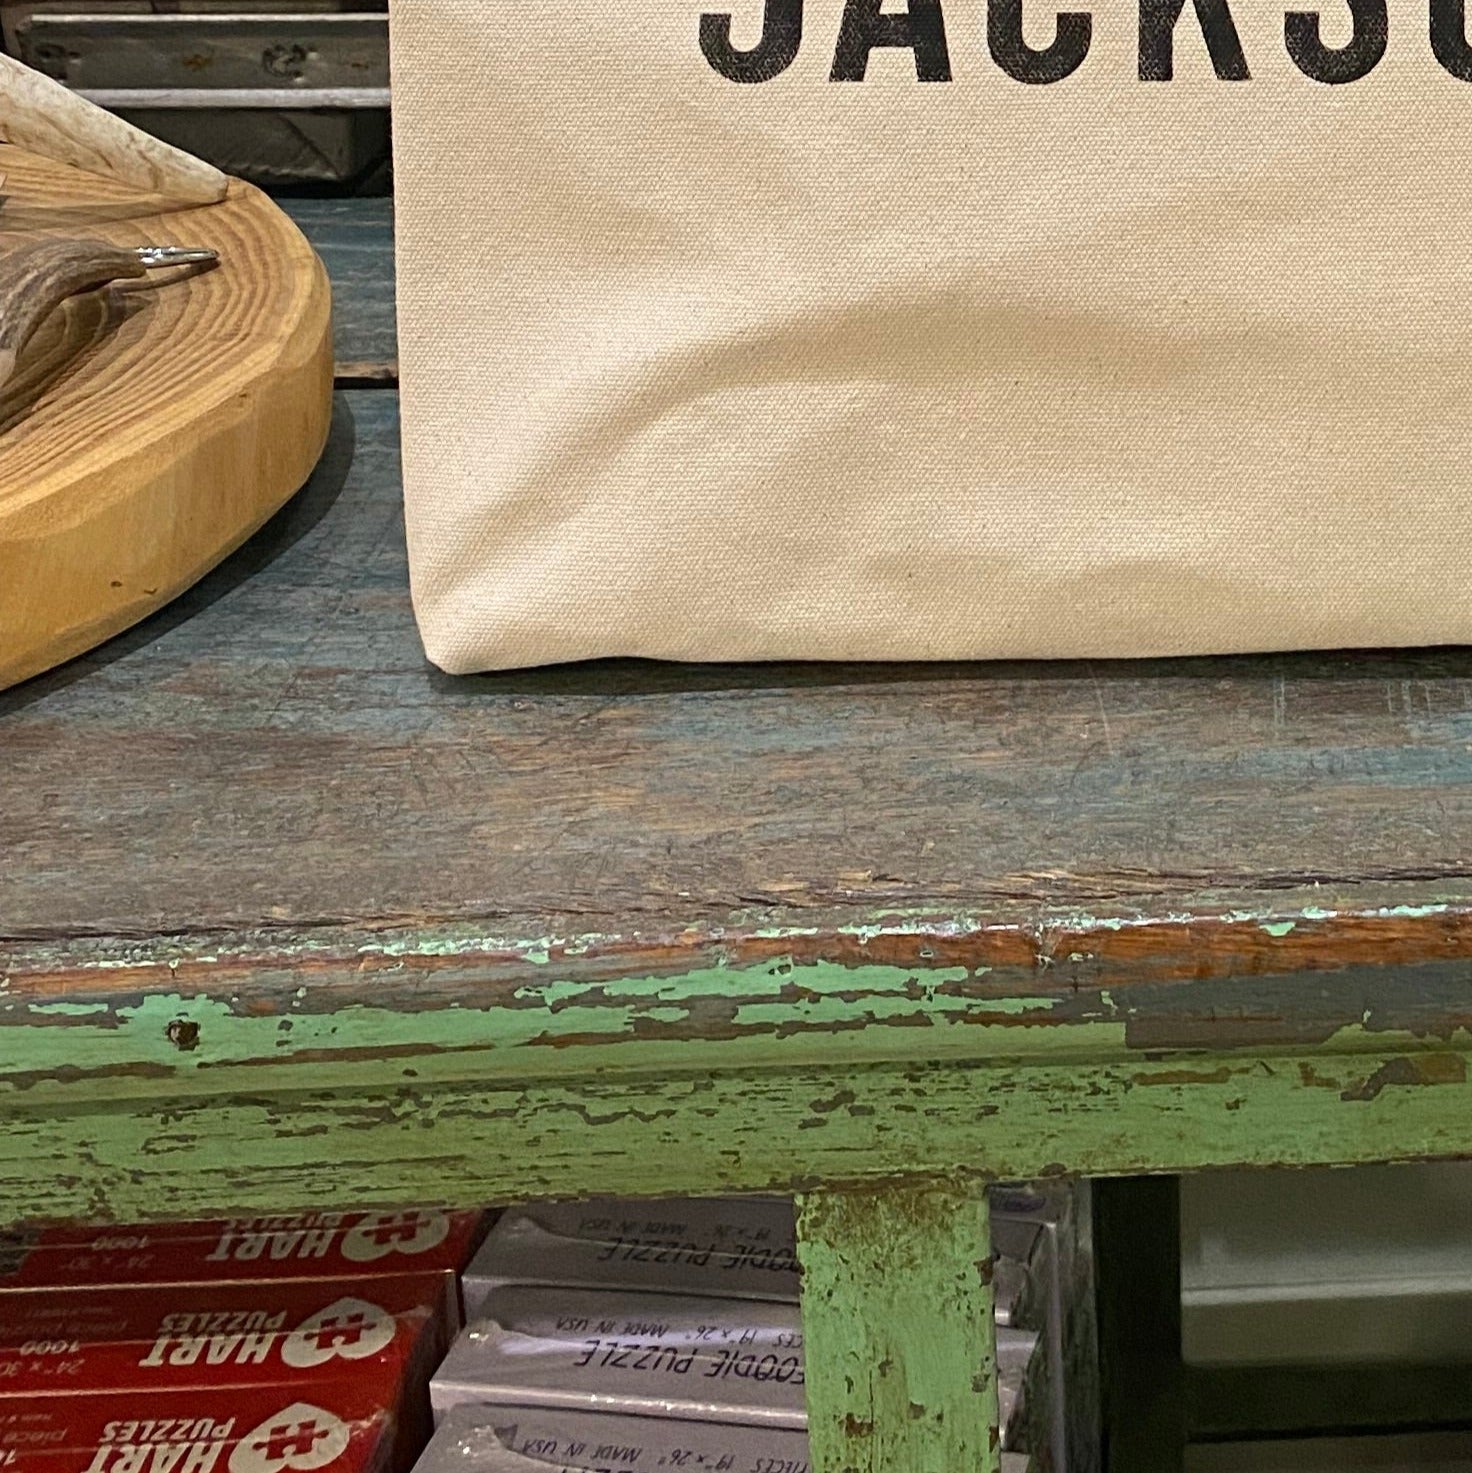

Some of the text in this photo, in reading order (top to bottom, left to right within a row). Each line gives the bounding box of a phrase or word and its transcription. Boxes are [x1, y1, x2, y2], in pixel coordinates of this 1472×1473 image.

[205, 1229, 338, 1261] HART
[598, 1237, 716, 1267] PUZZLE
[157, 1310, 288, 1332] PUZZLES
[556, 1317, 588, 1329] USA
[597, 1320, 617, 1330] IN
[619, 1321, 668, 1338] MADE
[19, 1339, 80, 1356] 1000
[138, 1332, 279, 1367] HART
[574, 1339, 805, 1385] FOODIE PUZZLE
[99, 1416, 236, 1443] PUZZLES
[80, 1440, 225, 1473] HART
[523, 1439, 556, 1455] USA
[564, 1442, 587, 1457] IN
[591, 1445, 643, 1463] MADE
